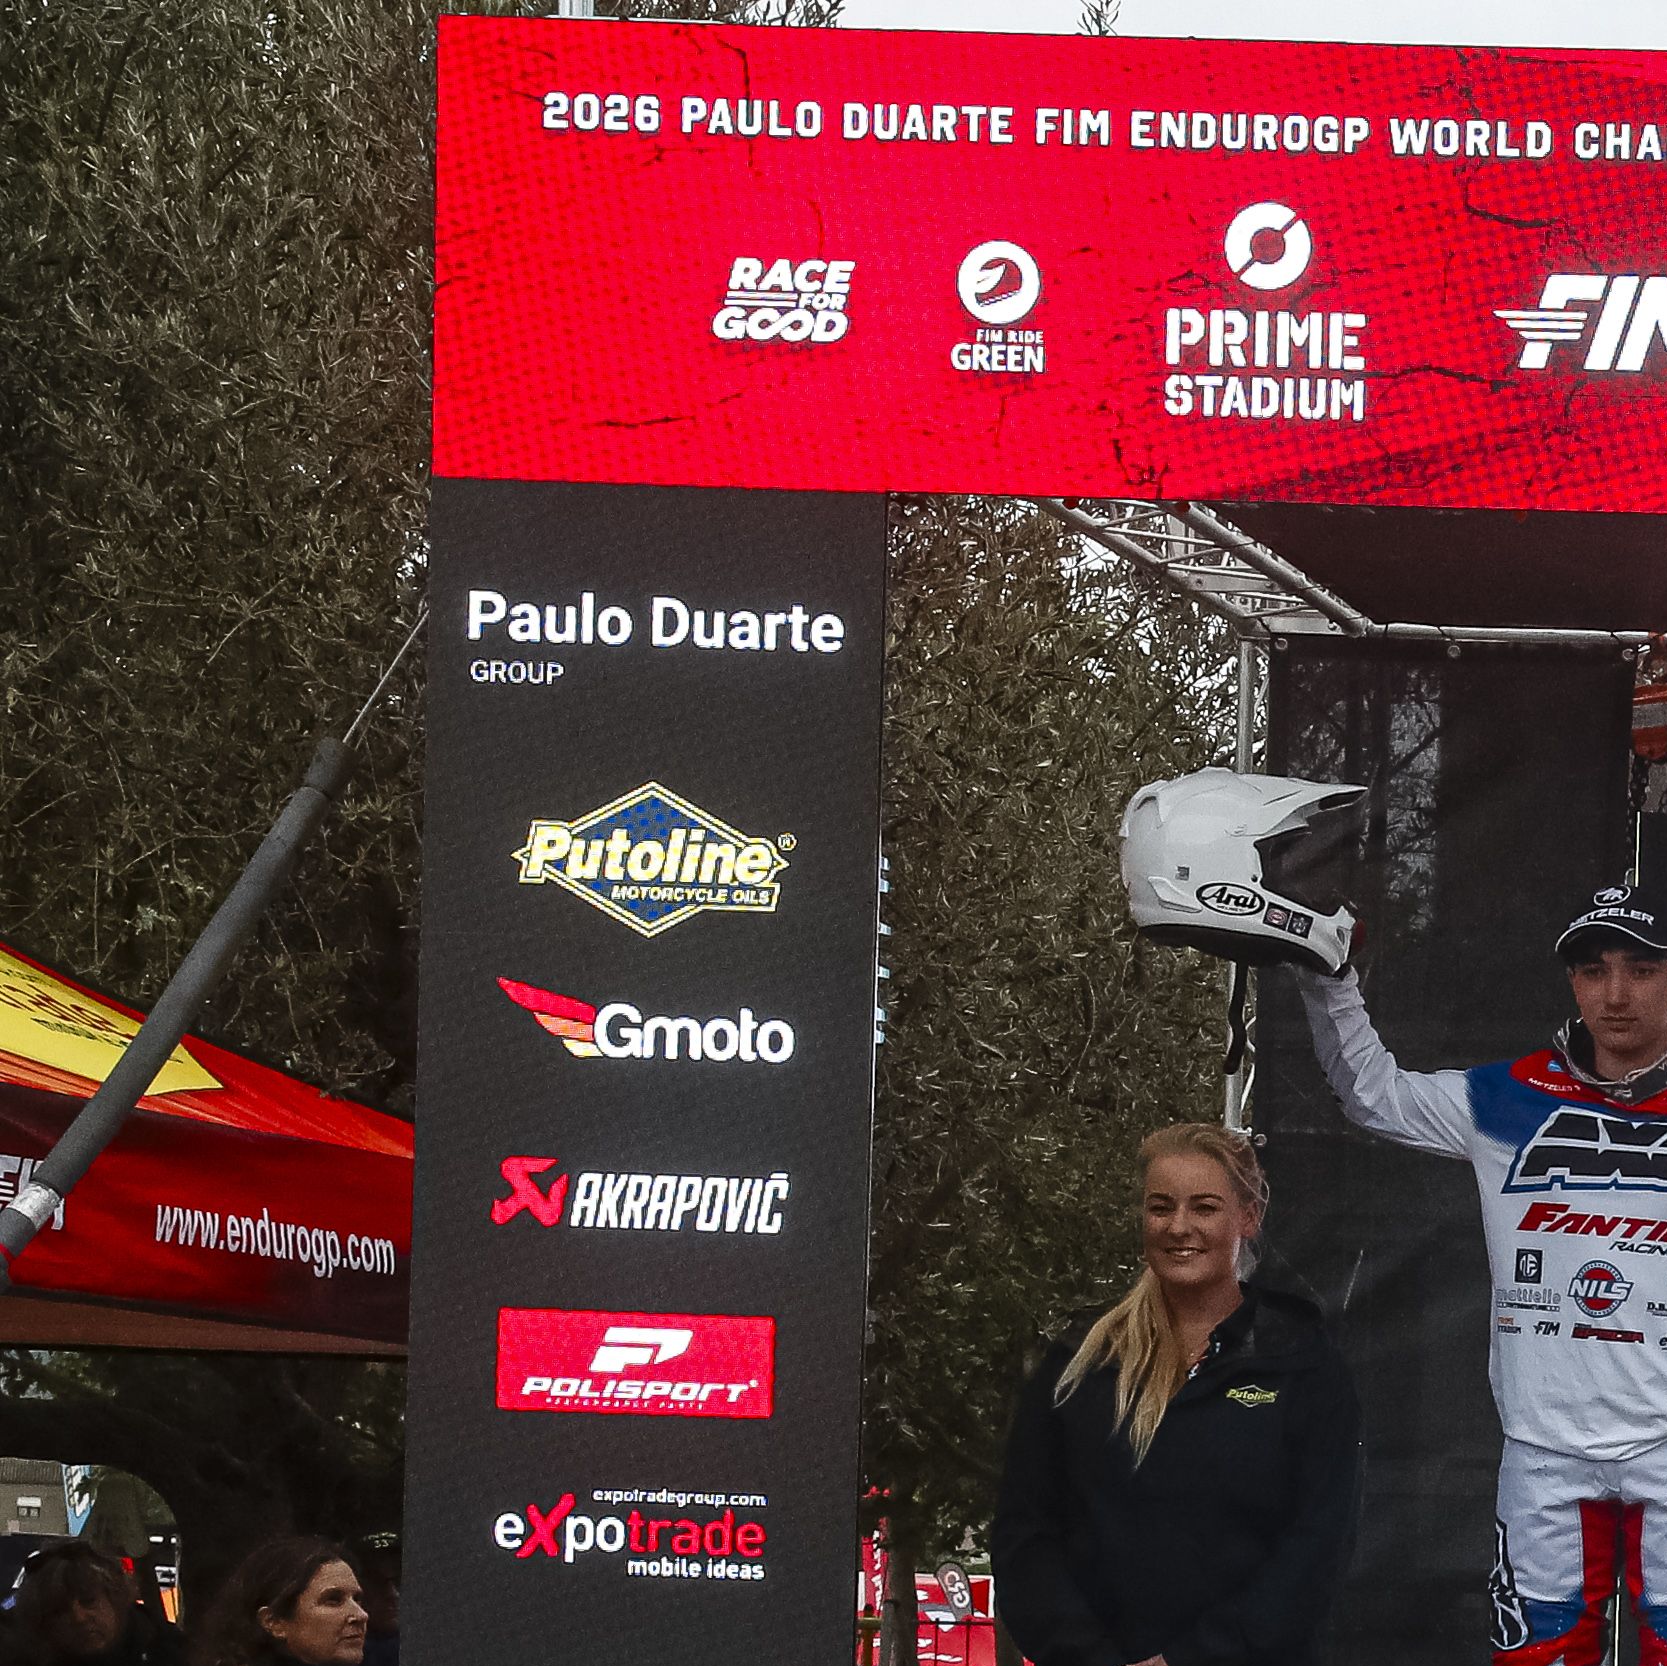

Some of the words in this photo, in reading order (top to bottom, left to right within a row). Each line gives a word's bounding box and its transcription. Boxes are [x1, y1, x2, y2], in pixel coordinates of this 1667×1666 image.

[543, 92, 660, 132] 2026
[681, 96, 822, 140] PAULO
[843, 101, 1014, 145] DUARTE
[1034, 107, 1110, 147] FIM
[1130, 110, 1370, 155] ENDUROGP
[1390, 118, 1552, 158] WORLD
[728, 256, 855, 294] RACE
[798, 292, 845, 311] FOR
[712, 307, 851, 344] GOOD
[976, 329, 1005, 343] FIM
[1166, 309, 1368, 372] PRIME
[950, 343, 1045, 374] GREEN
[1164, 374, 1366, 421] STADIUM
[467, 590, 633, 645] Paulo
[651, 596, 845, 653] Duarte
[470, 660, 565, 684] GROUP
[524, 826, 776, 886] Putoline
[1210, 886, 1259, 909] Arai
[594, 1002, 796, 1064] Gmoto
[155, 1204, 396, 1279] www.endurogp.com
[1568, 1278, 1634, 1301] NILS
[1533, 1321, 1560, 1336] FIM
[521, 1376, 749, 1403] POLISPORT
[626, 1558, 702, 1579] mobile
[706, 1559, 765, 1581] ideas
